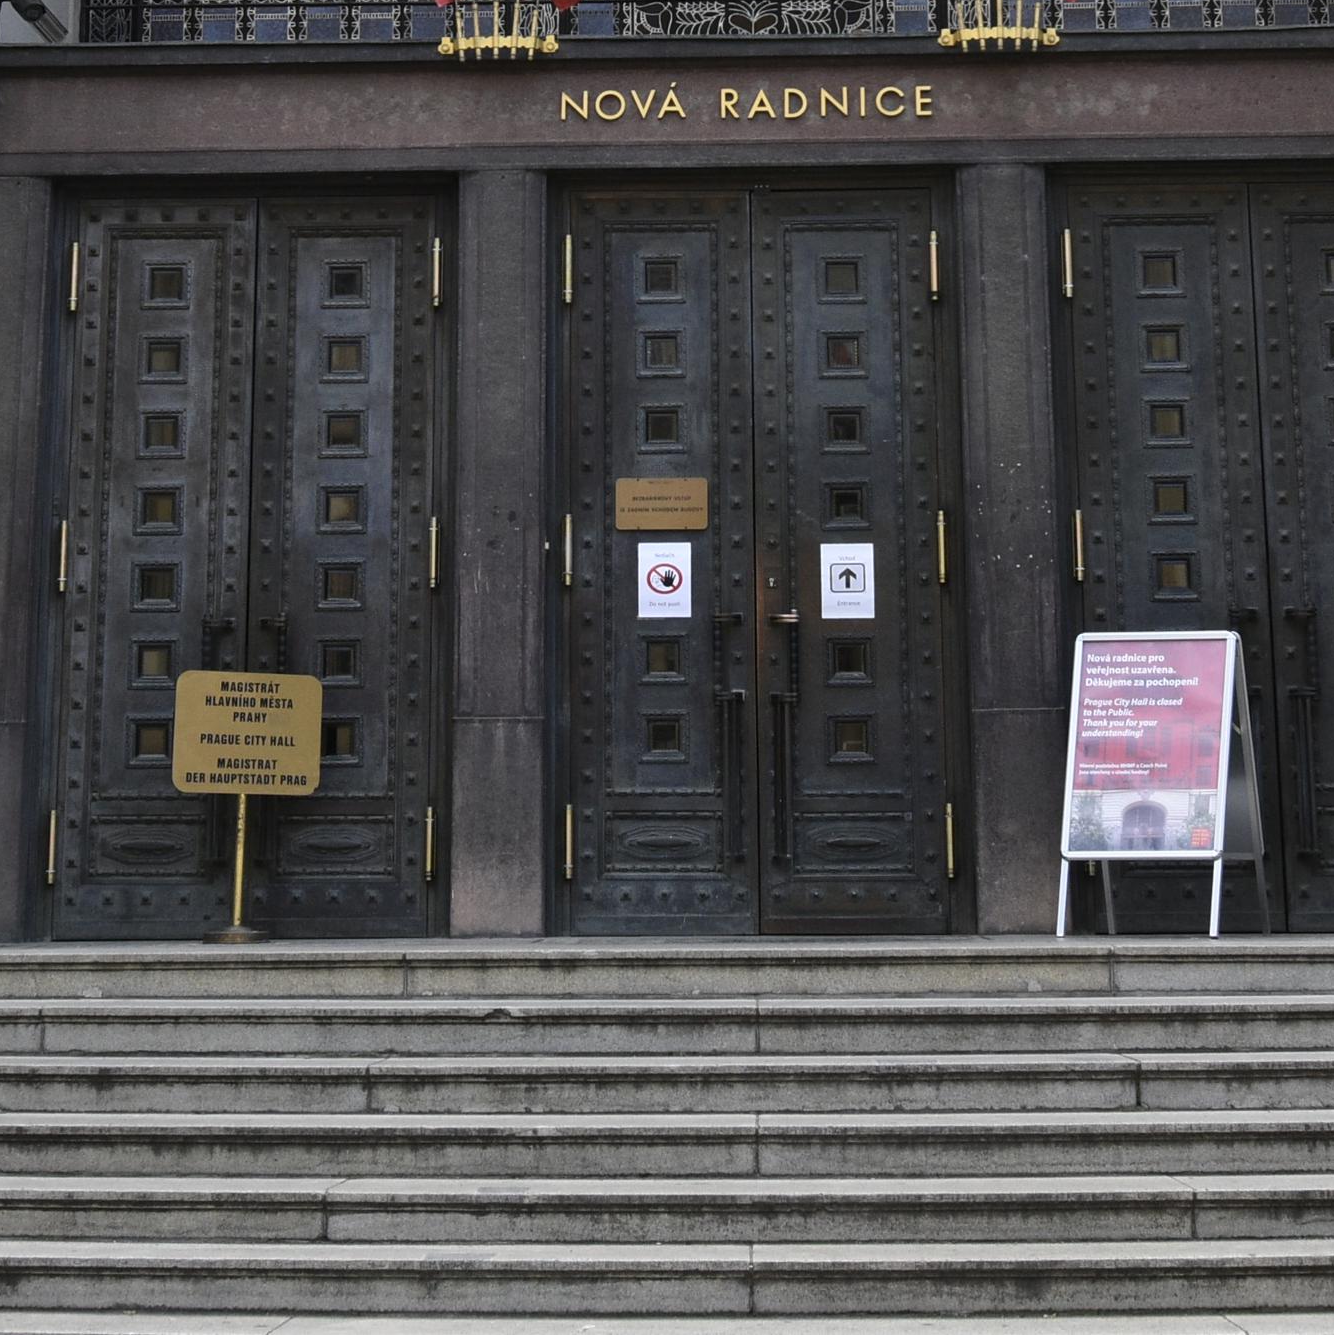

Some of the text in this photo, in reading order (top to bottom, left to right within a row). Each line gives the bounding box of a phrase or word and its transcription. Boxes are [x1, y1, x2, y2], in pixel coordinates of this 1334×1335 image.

[560, 82, 933, 120] NOVÁ RADNICE
[1087, 653, 1165, 664] Nová radnice pro
[1086, 665, 1177, 676] veřejnost uzavřena.
[220, 680, 281, 694] MAGISTRÁT
[1085, 677, 1132, 687] Děkujeme
[205, 694, 293, 709] HLAVNÍHO MĚSTA
[1083, 697, 1183, 707] Prague City Hall is closed
[233, 712, 267, 723] PRAHY
[1093, 708, 1106, 716] the
[1107, 708, 1135, 716] Public.
[1108, 720, 1124, 728] you
[1126, 718, 1139, 727] for
[1139, 720, 1158, 728] your
[1081, 729, 1144, 739] understanding!
[200, 733, 296, 747] PRAGUE CITY HALL
[217, 758, 278, 770] MAGISTRAT
[185, 772, 307, 786] DER HAUPTSTADT PRAG
